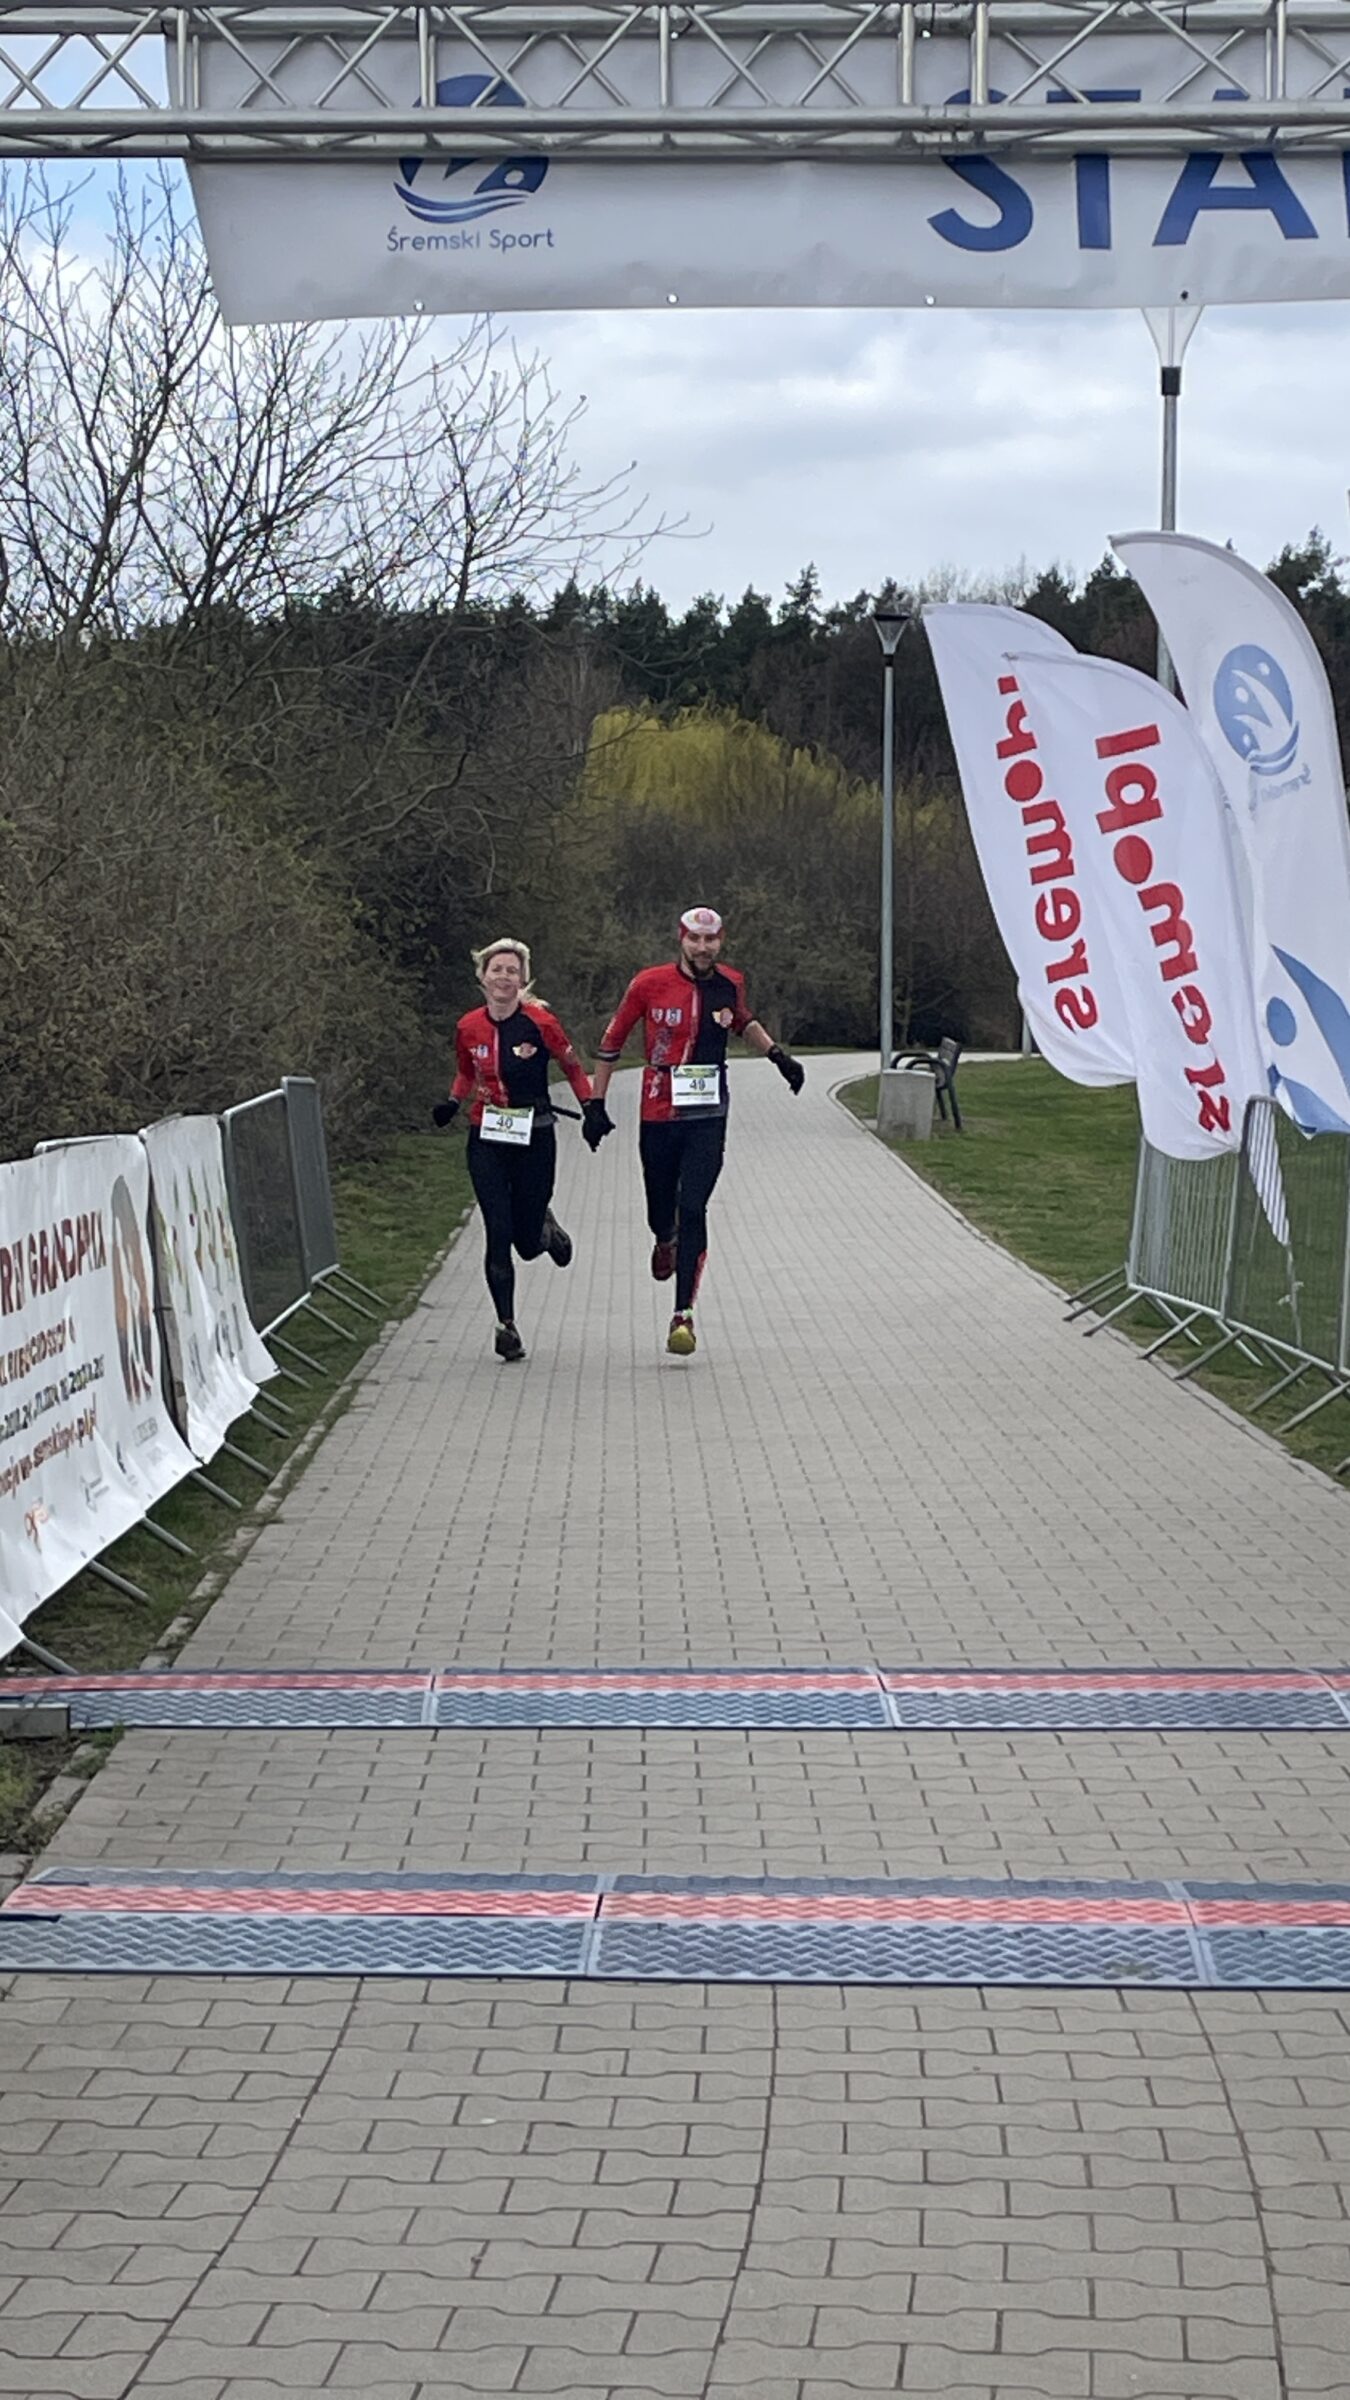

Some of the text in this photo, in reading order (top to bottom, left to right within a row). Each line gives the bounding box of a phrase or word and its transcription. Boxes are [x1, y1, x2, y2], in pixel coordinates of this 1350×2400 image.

[927, 89, 1350, 252] STA
[387, 225, 555, 254] Śremski Sport
